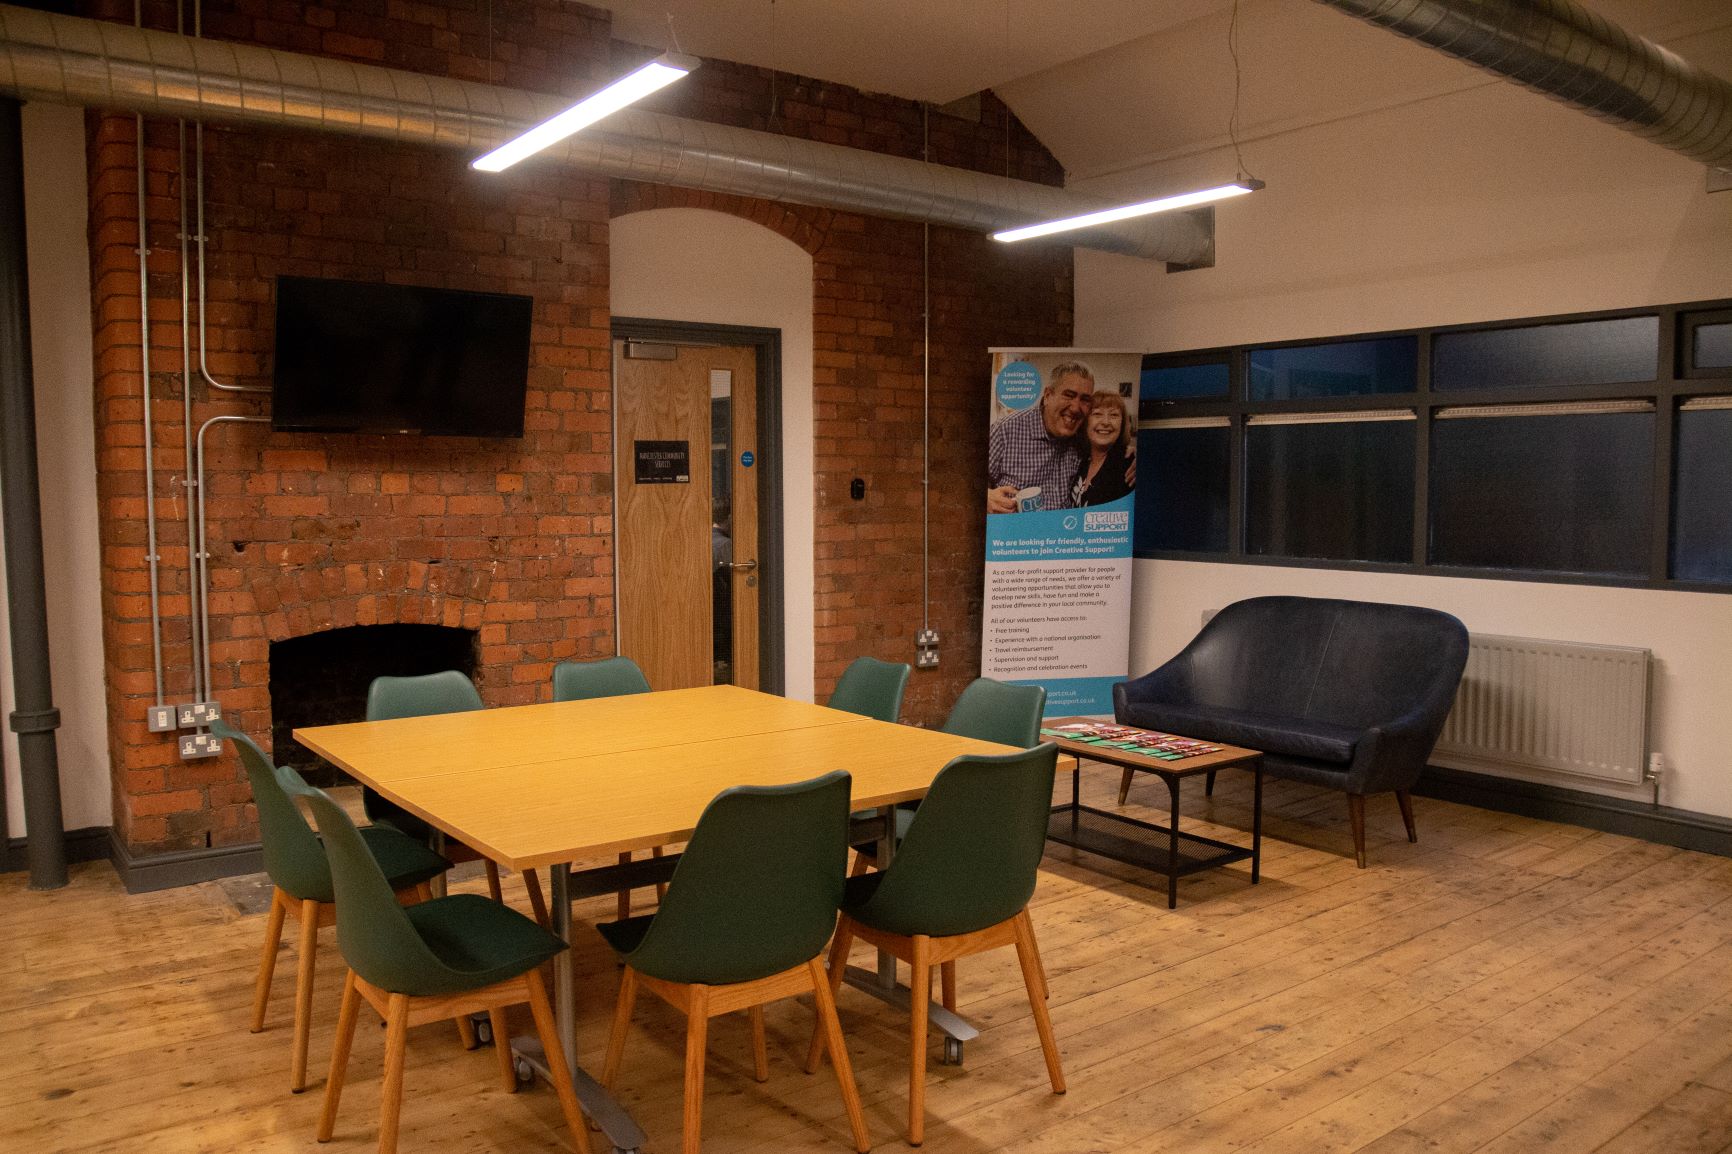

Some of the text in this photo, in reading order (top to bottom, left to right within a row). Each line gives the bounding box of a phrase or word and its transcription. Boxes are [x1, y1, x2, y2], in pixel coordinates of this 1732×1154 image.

[1004, 371, 1026, 379] Looking
[992, 539, 1004, 547] We
[1019, 539, 1045, 547] looking
[1057, 537, 1086, 546] friendly,
[1087, 536, 1129, 544] enthusiastic
[992, 548, 1029, 556] volunteers
[1039, 547, 1053, 556] join
[1084, 546, 1114, 555] Support!
[1067, 634, 1101, 642] organisation
[994, 656, 1026, 664] Supervision
